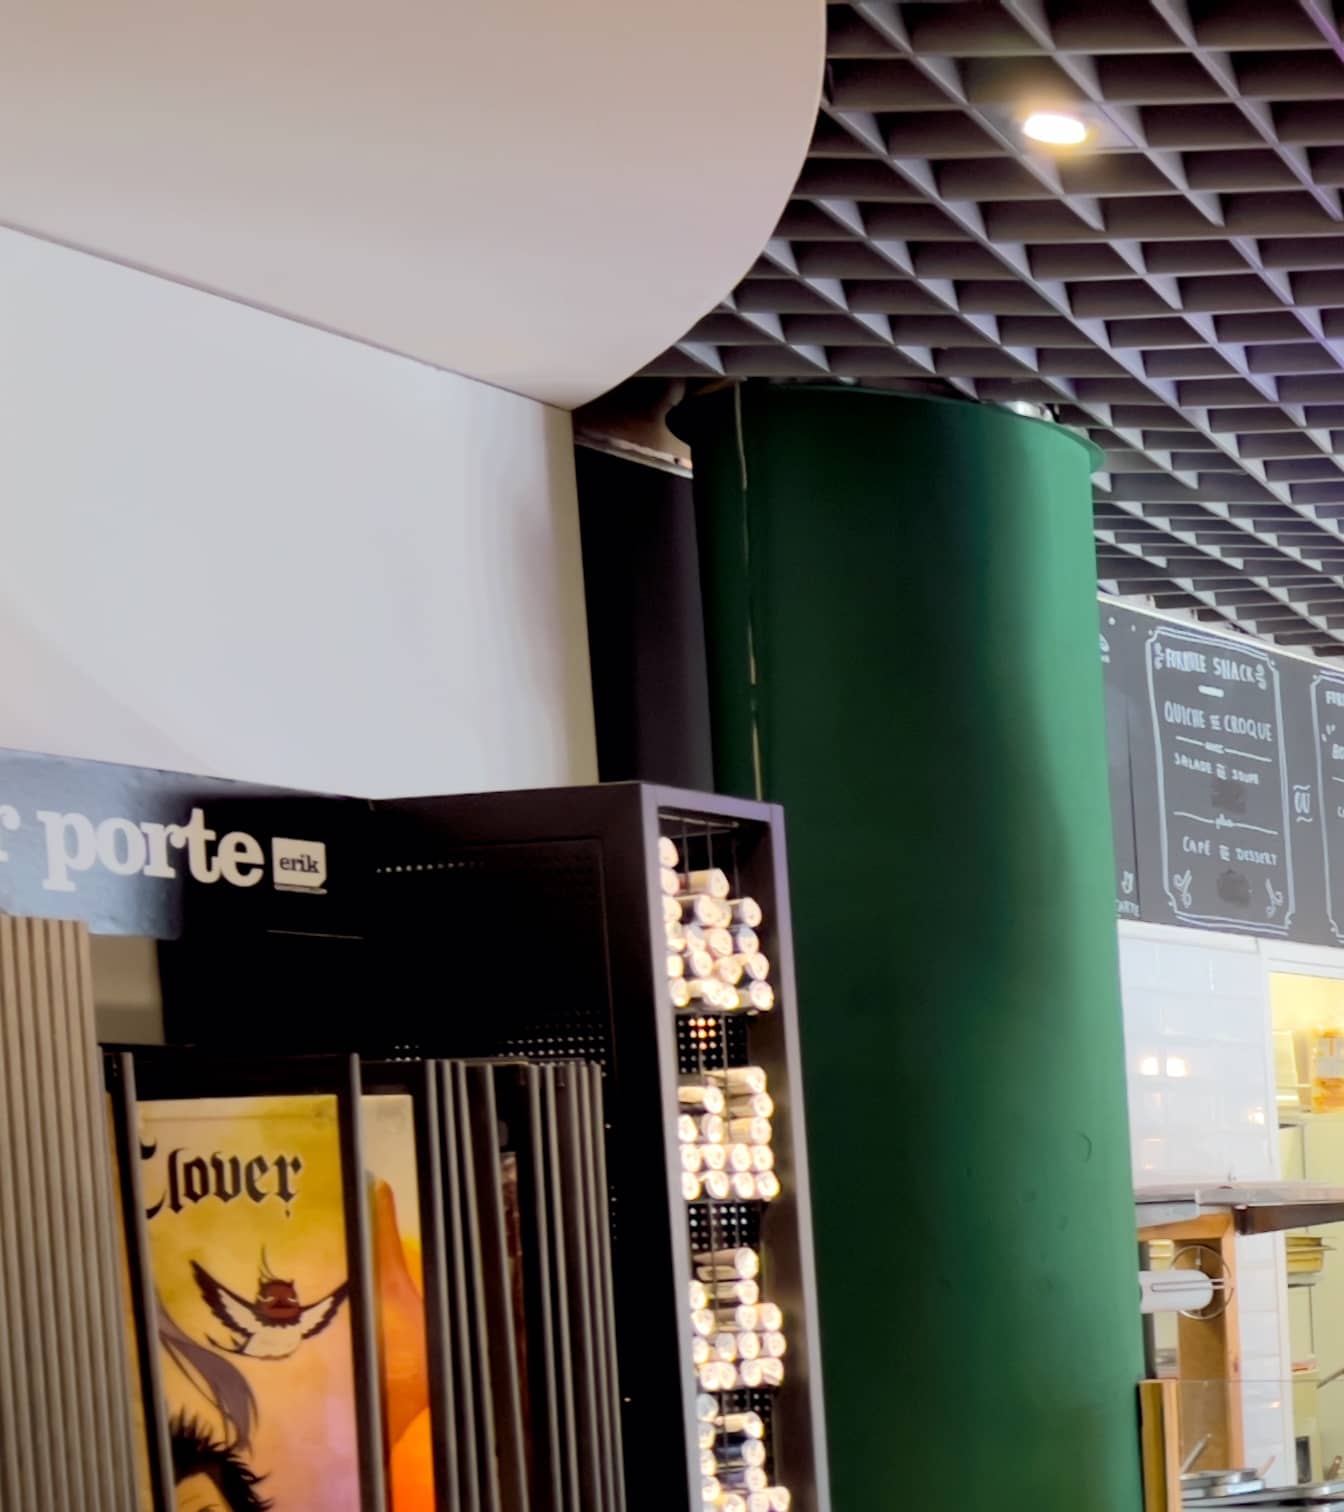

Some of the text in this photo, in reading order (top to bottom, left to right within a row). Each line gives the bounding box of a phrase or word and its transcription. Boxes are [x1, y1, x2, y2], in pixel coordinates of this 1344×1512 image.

[1224, 714, 1273, 742] CROQUE
[36, 807, 266, 892] porte
[279, 853, 321, 874] erik
